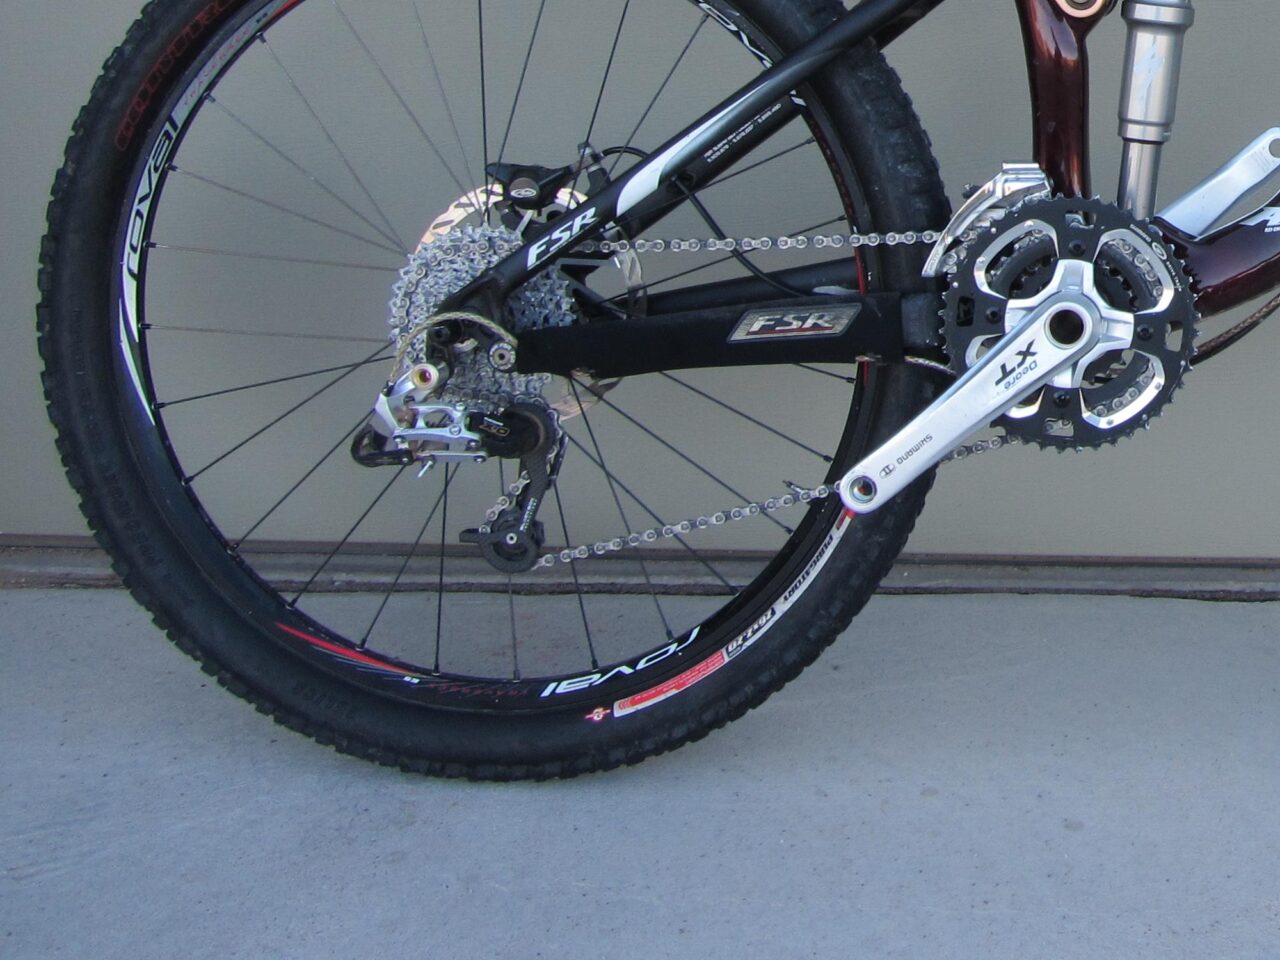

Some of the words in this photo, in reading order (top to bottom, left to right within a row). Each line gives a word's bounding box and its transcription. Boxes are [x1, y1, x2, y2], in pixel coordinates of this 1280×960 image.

[126, 113, 181, 282] roval
[526, 206, 598, 269] FSR
[747, 311, 834, 333] FSR
[994, 338, 1038, 387] XT
[1003, 360, 1038, 390] Deore
[896, 433, 934, 465] SHIMANO
[783, 533, 835, 603] PURGATORY
[540, 625, 700, 698] roval
